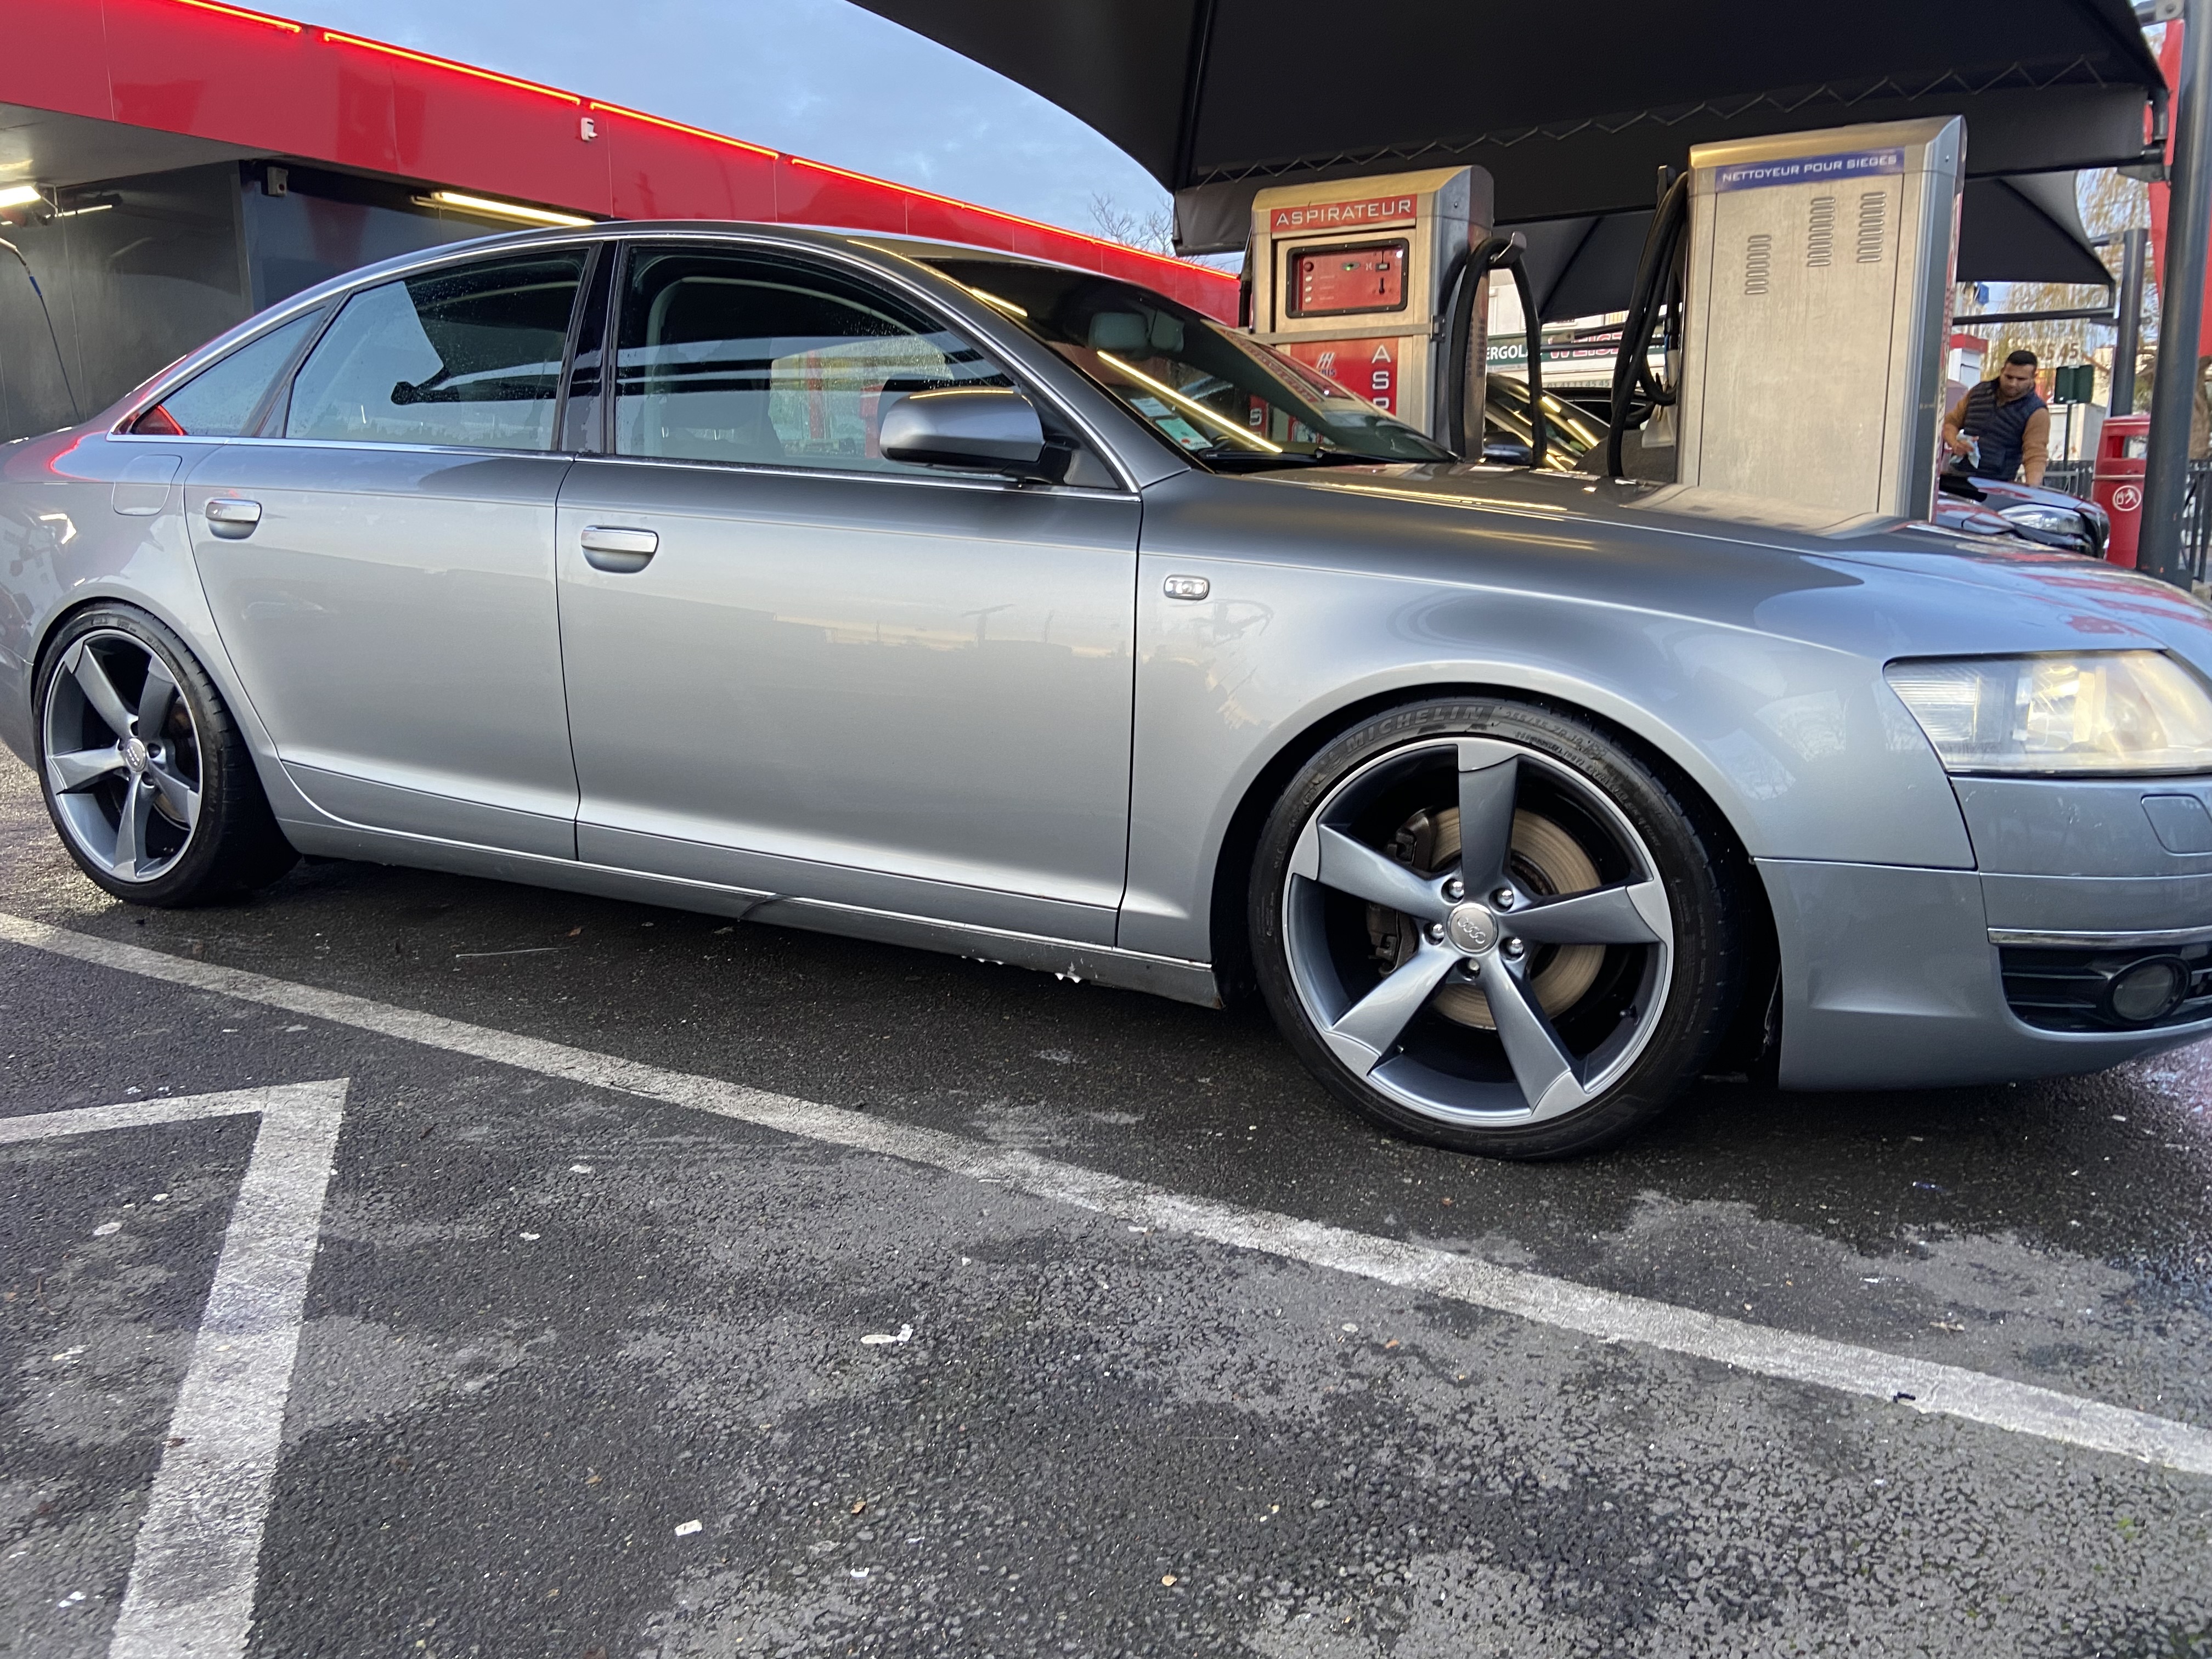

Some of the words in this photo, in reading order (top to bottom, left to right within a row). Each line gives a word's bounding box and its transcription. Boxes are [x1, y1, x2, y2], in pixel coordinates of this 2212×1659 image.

[1723, 165, 1799, 183] NETTOYEUR
[1804, 160, 1842, 174] POUR
[1847, 154, 1897, 170] SIEGES
[1276, 199, 1412, 227] ASPIRATEUR
[1345, 706, 1484, 753] MICHELIN
